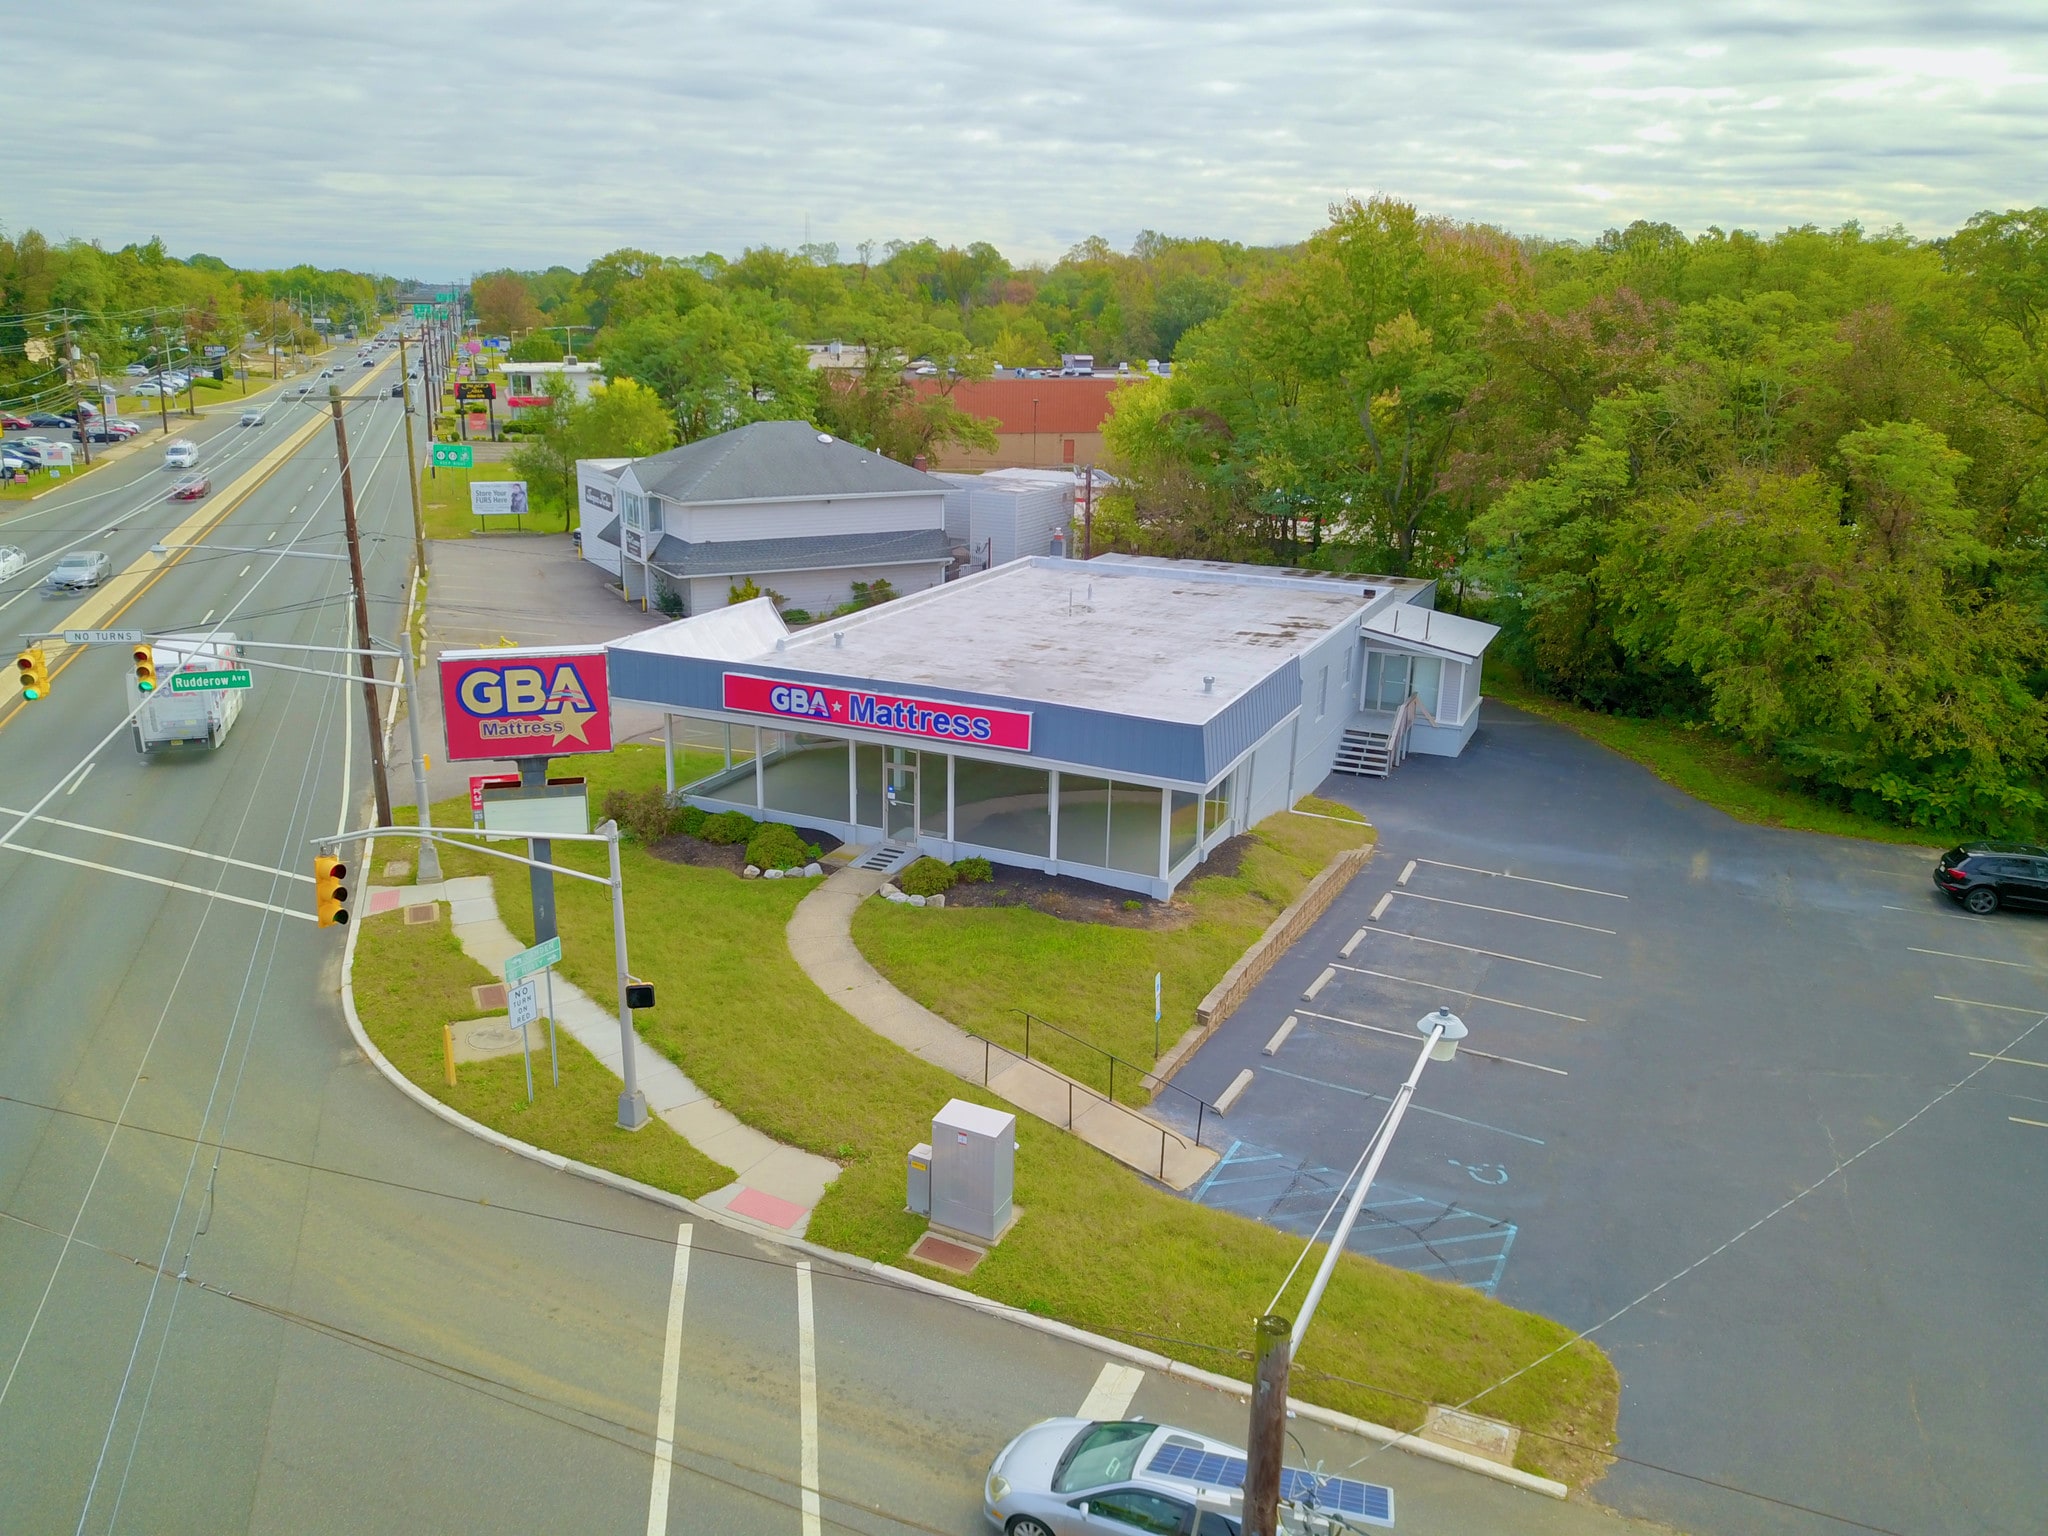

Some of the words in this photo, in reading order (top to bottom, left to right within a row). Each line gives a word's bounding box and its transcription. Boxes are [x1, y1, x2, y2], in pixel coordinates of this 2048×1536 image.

[74, 631, 90, 642] NO
[95, 631, 133, 642] TURNS
[175, 676, 230, 689] Rudderow
[232, 674, 247, 682] Ave
[457, 663, 597, 717] GBA
[770, 686, 831, 718] GBA
[849, 694, 991, 740] Mattress
[482, 721, 564, 737] Mattress
[514, 987, 528, 998] NO
[513, 996, 532, 1008] TURN
[518, 1005, 528, 1015] ON
[517, 1013, 531, 1023] RED
